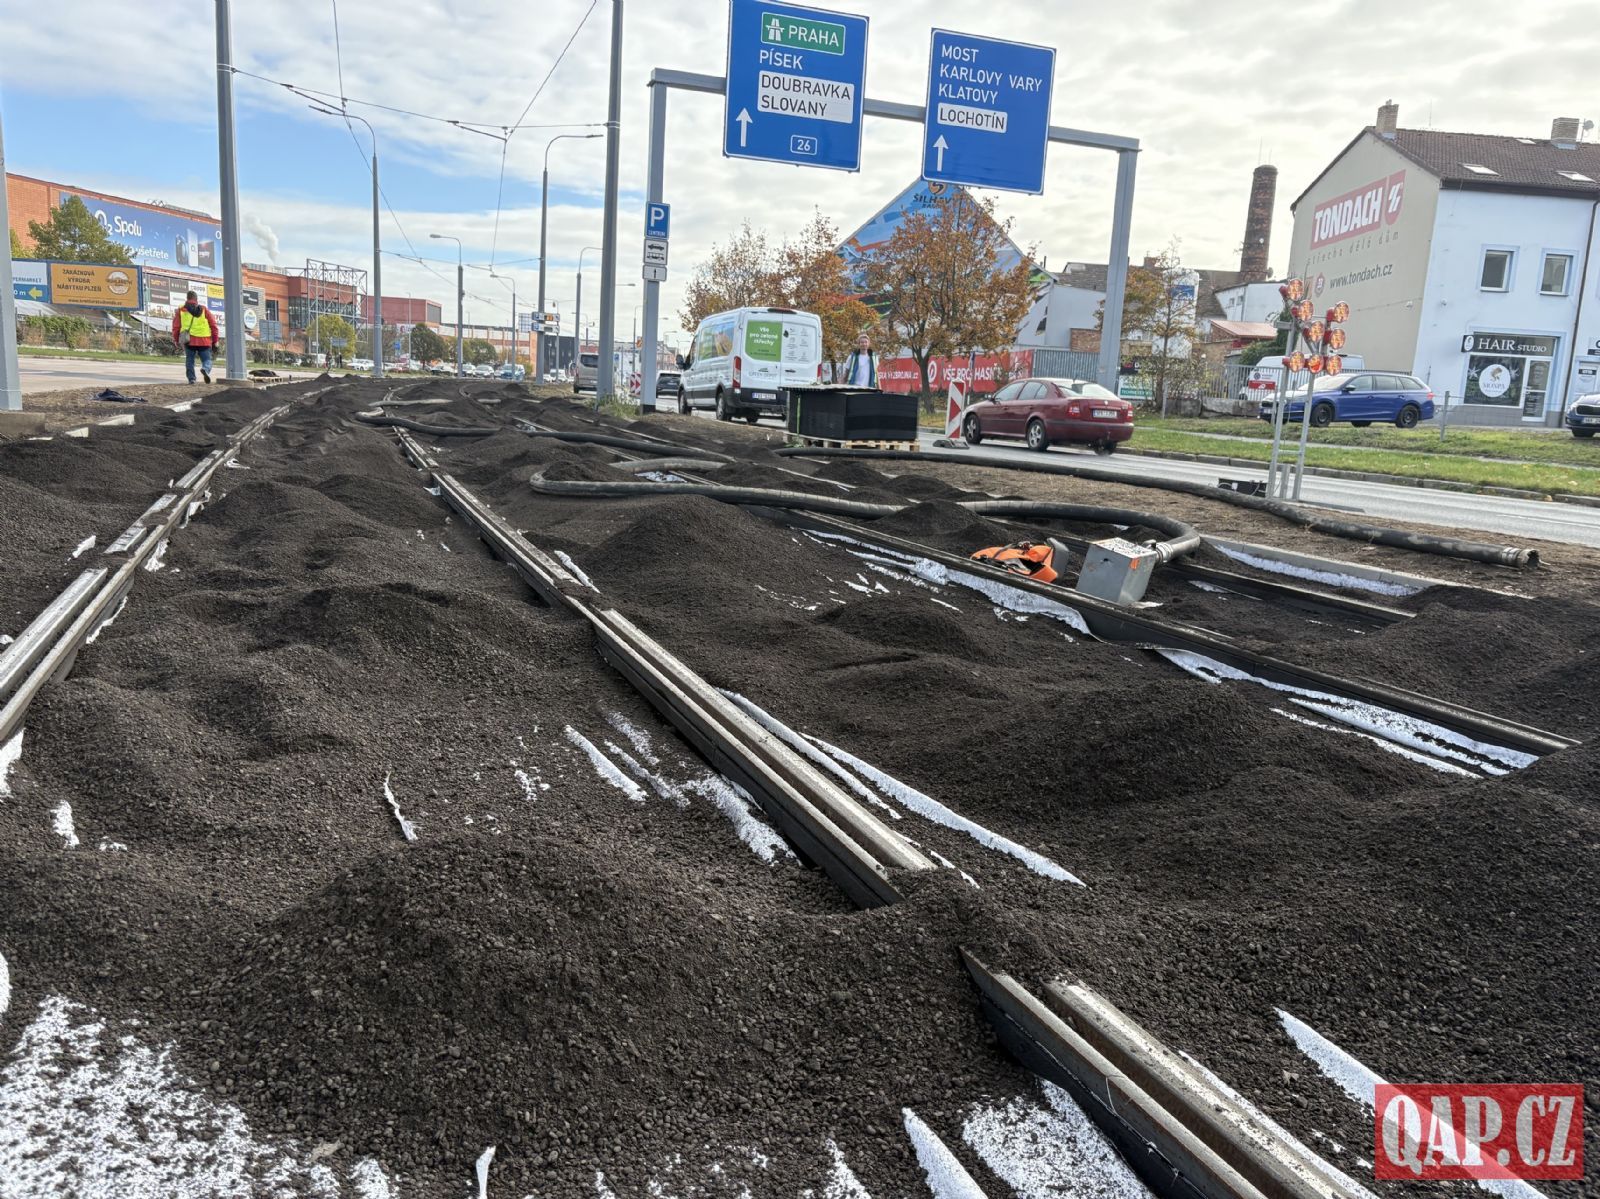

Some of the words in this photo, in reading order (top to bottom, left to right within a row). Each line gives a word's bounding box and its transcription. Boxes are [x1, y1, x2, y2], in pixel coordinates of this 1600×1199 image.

[788, 25, 840, 47] PRAHA
[759, 48, 803, 70] PÍSEK
[941, 43, 979, 63] MOST
[761, 74, 851, 100] DOUBRAVKA
[940, 63, 1003, 86] KARLOVY
[1009, 74, 1042, 92] VARY
[938, 83, 998, 105] KLATOVY
[761, 94, 828, 117] SLOVANY
[940, 107, 1005, 130] LOCHOTÍN
[796, 139, 811, 152] 26
[650, 207, 665, 227] P
[1314, 187, 1383, 243] TONDACH
[114, 216, 142, 237] Spolu
[1329, 263, 1393, 289] www.tondach.cz
[1478, 337, 1515, 351] HAIR
[1517, 344, 1547, 352] STUDIO
